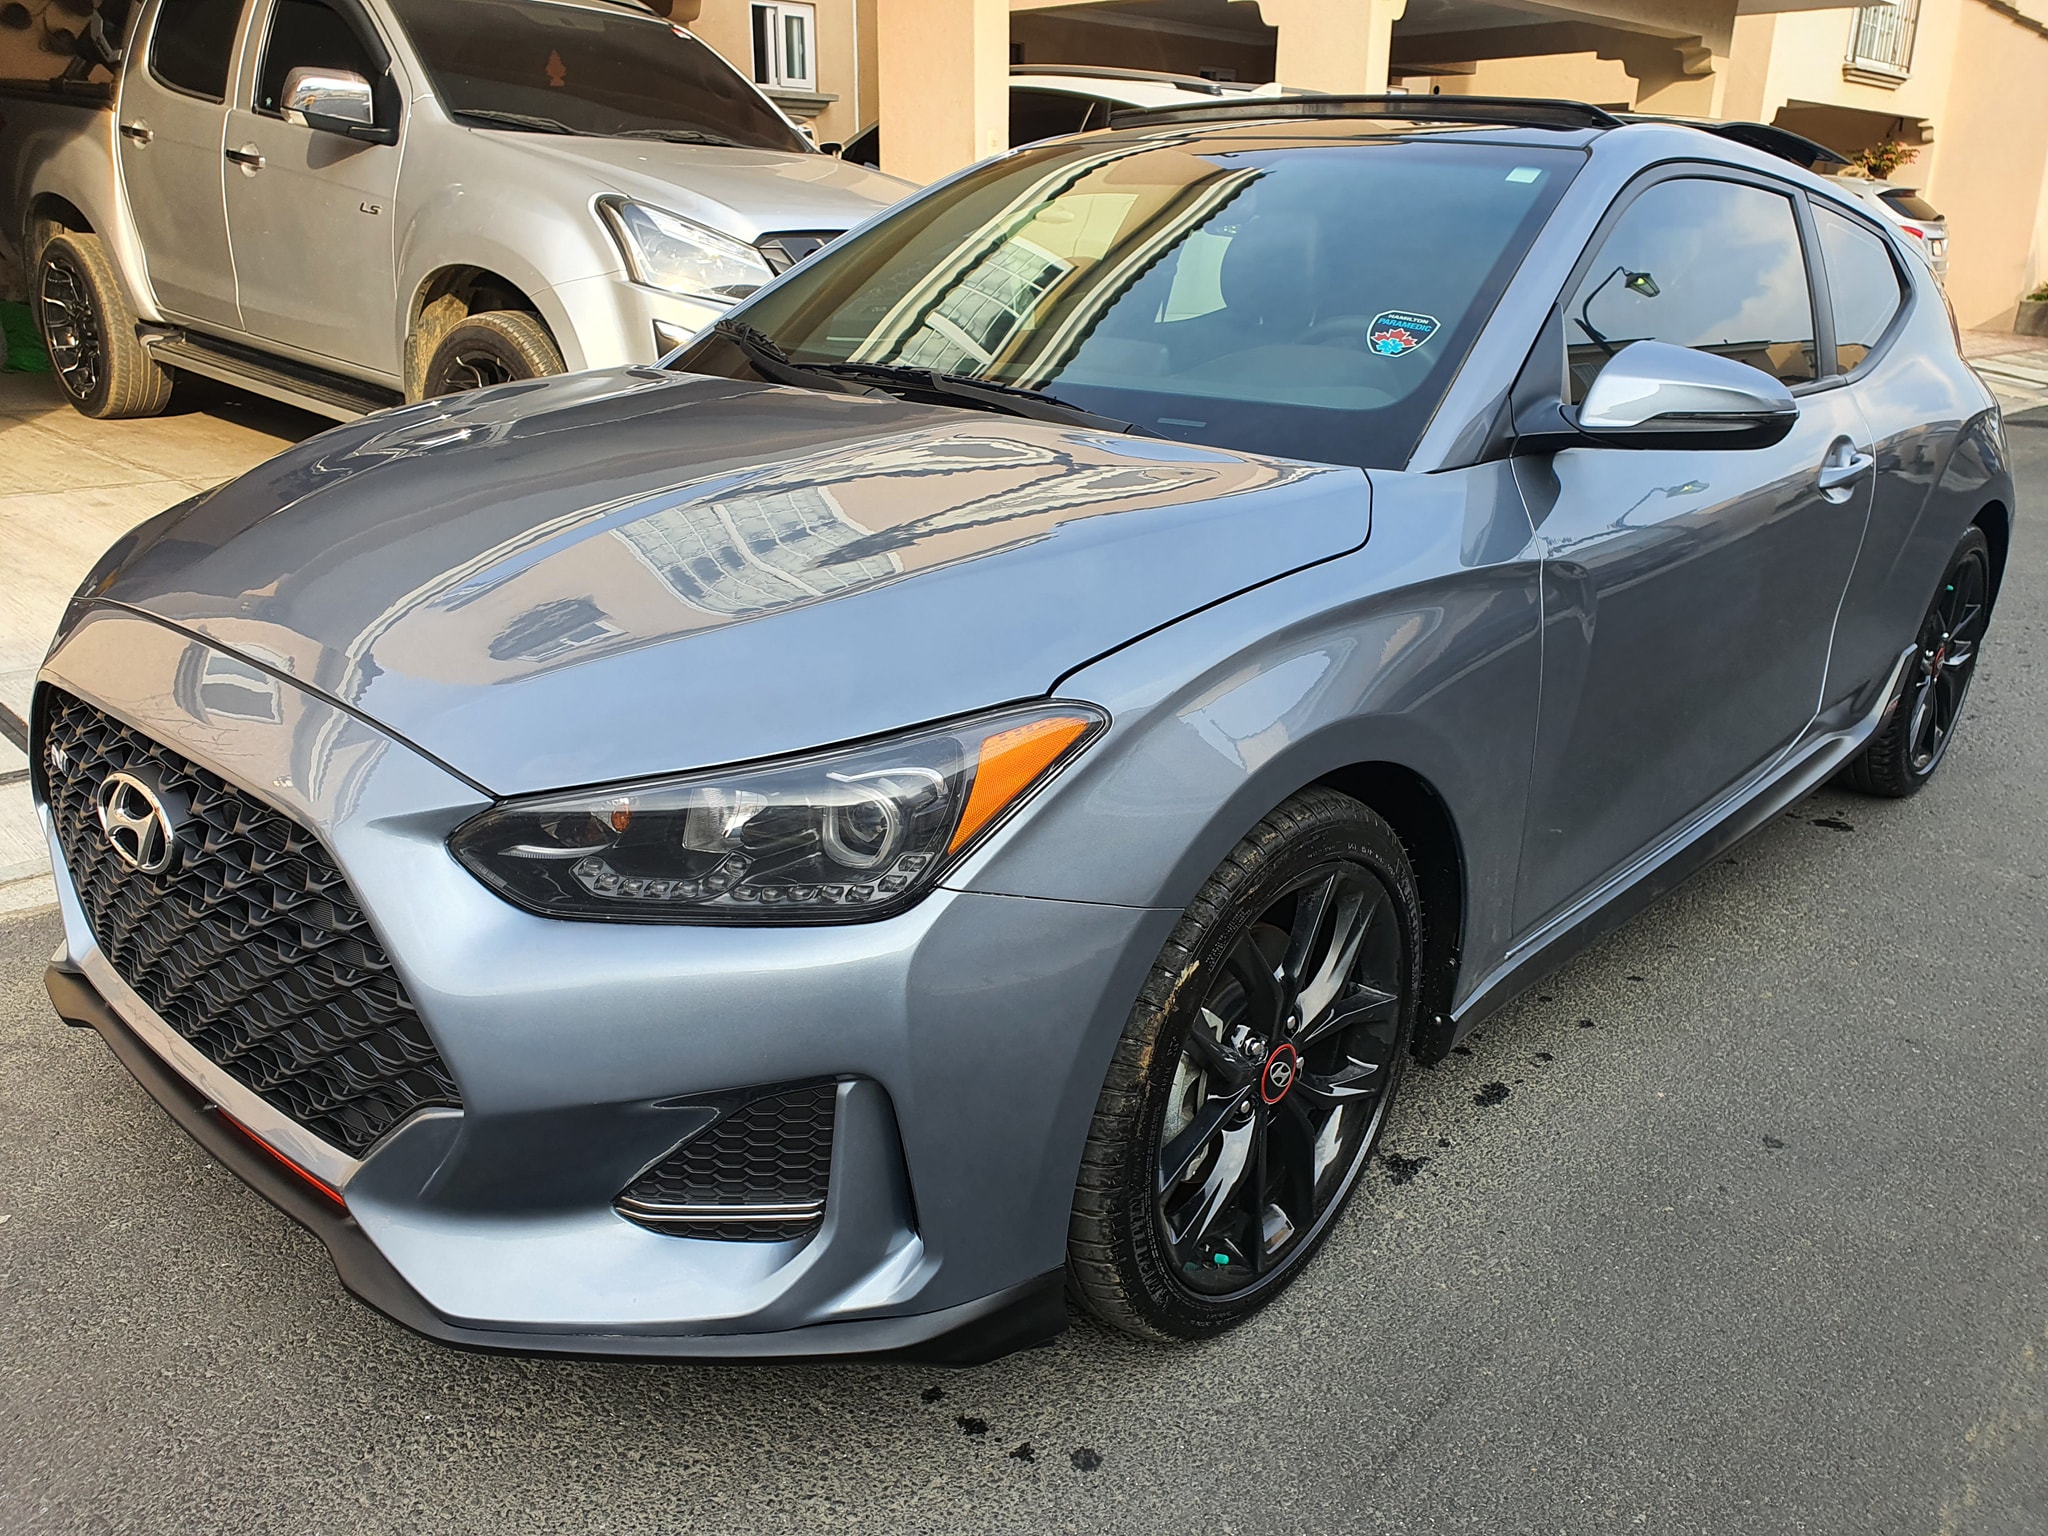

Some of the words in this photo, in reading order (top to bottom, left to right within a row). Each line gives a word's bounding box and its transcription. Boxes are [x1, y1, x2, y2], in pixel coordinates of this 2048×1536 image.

[360, 202, 381, 215] LS
[1378, 318, 1432, 332] PARAMEDIC
[1388, 314, 1429, 324] HAMILTON
